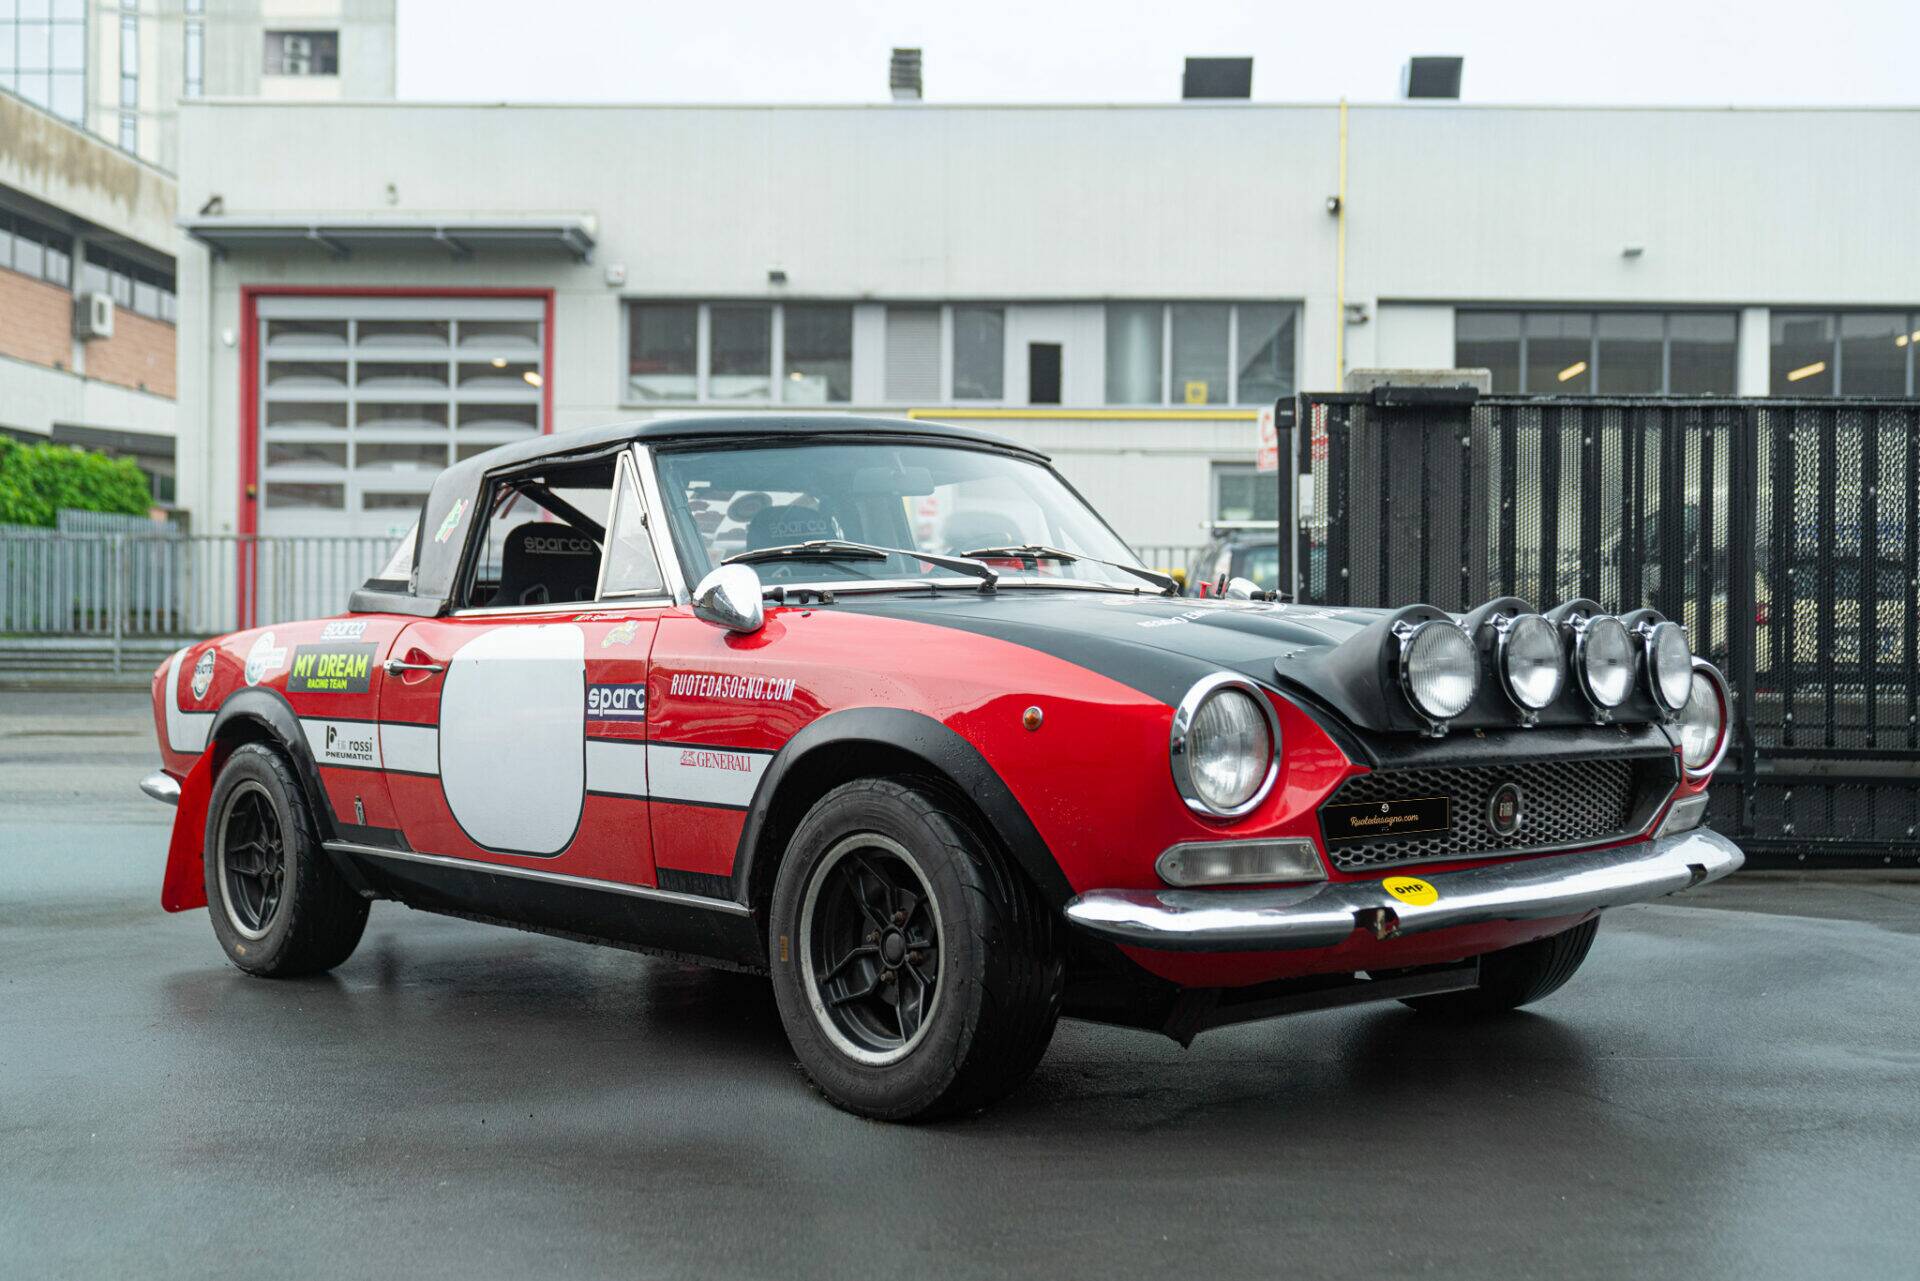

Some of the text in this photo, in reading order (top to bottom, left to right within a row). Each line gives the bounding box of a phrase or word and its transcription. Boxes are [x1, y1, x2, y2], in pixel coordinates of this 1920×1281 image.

[769, 520, 828, 539] sparco
[524, 536, 593, 554] sparco
[321, 621, 368, 640] sparco
[293, 654, 317, 678] MY
[317, 653, 369, 678] DREAM
[307, 679, 348, 689] RACING TEAM
[670, 673, 796, 701] RUOTEDASOGNO.COM
[349, 737, 373, 752] rossi
[697, 752, 752, 772] GENERALI
[1350, 813, 1419, 828] Ruotedasogno.com
[1396, 884, 1424, 895] OMP
